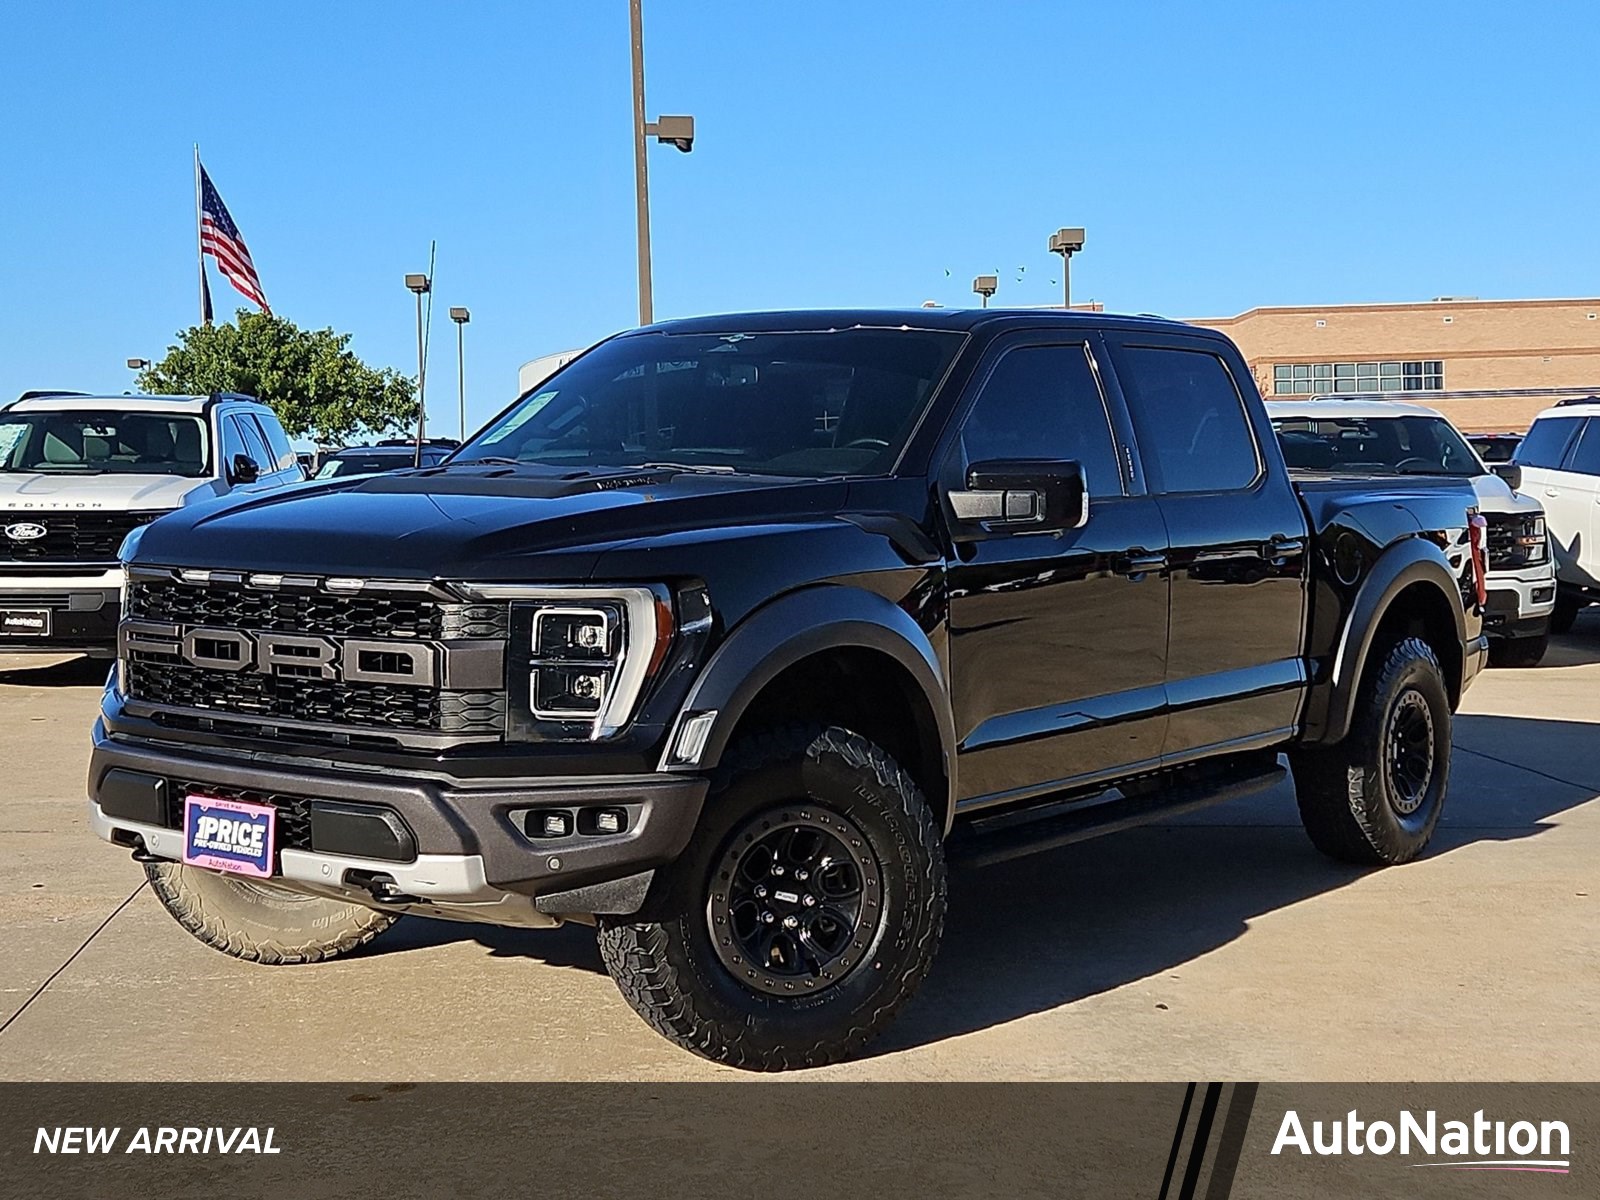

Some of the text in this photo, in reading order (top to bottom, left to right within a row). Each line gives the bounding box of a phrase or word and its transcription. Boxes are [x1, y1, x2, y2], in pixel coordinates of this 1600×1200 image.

[10, 525, 41, 537] Ford
[119, 618, 434, 686] FORD
[193, 839, 262, 857] PRE-OWNED VEHICLES
[208, 859, 242, 870] AutoNation
